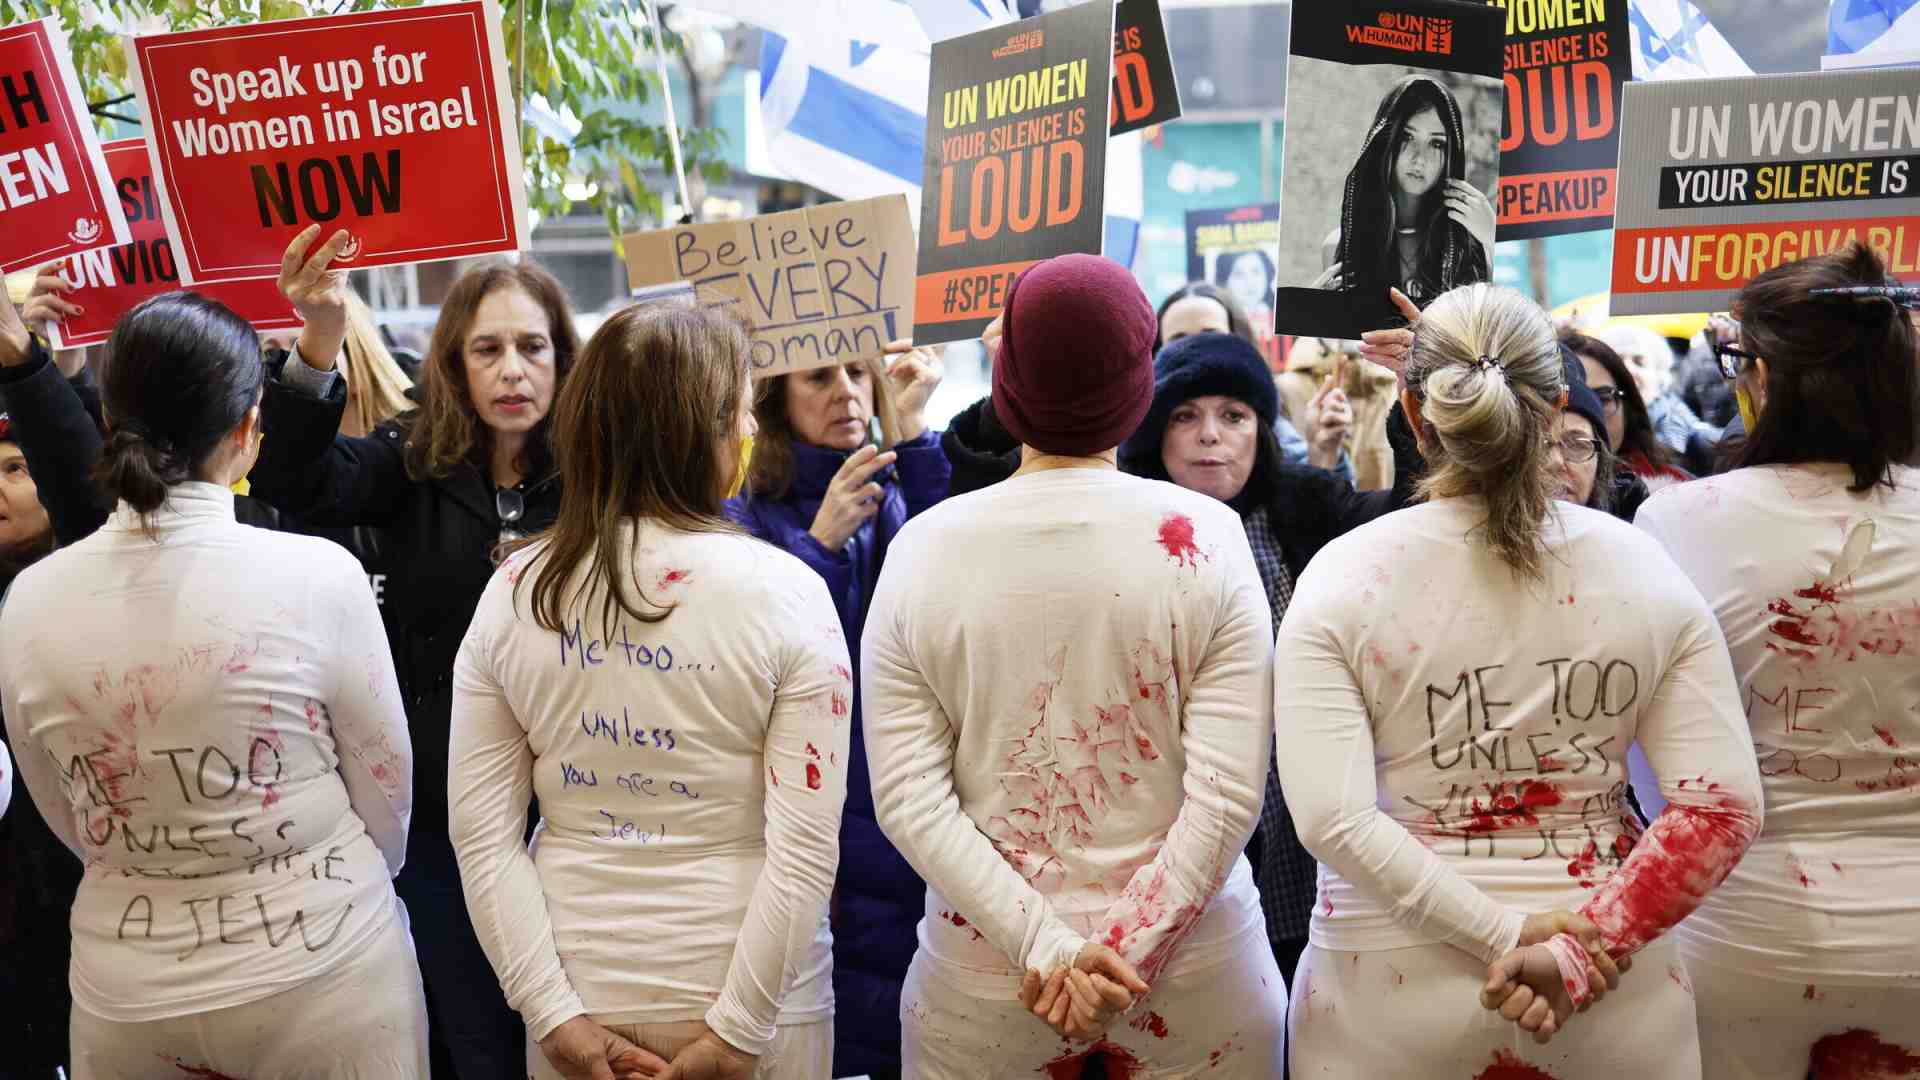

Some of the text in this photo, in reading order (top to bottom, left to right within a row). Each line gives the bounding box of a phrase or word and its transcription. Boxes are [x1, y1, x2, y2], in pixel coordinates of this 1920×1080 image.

[190, 46, 429, 115] Speak up for
[1503, 31, 1609, 71] SILENCE IS
[172, 87, 477, 158] Women in Israel
[943, 58, 1088, 128] UN WOMEN
[942, 108, 1085, 163] YOUR SILENCE IS
[1668, 96, 1920, 160] UN WOMEN
[0, 142, 70, 212] EN
[251, 150, 400, 229] NOW
[938, 140, 1084, 247] LOUD
[1675, 160, 1910, 204] YOUR SILENCE IS
[674, 217, 866, 277] Believe
[694, 250, 887, 320] EVERY
[750, 311, 897, 369] oman!
[560, 619, 604, 671] Me
[1426, 658, 1638, 744] ME TOO
[1747, 685, 1837, 733] ME
[151, 737, 282, 804] TOO
[1431, 732, 1616, 775] UNLESS
[1754, 744, 1841, 782] OO
[670, 780, 699, 799] a
[118, 895, 354, 961] A JEW
